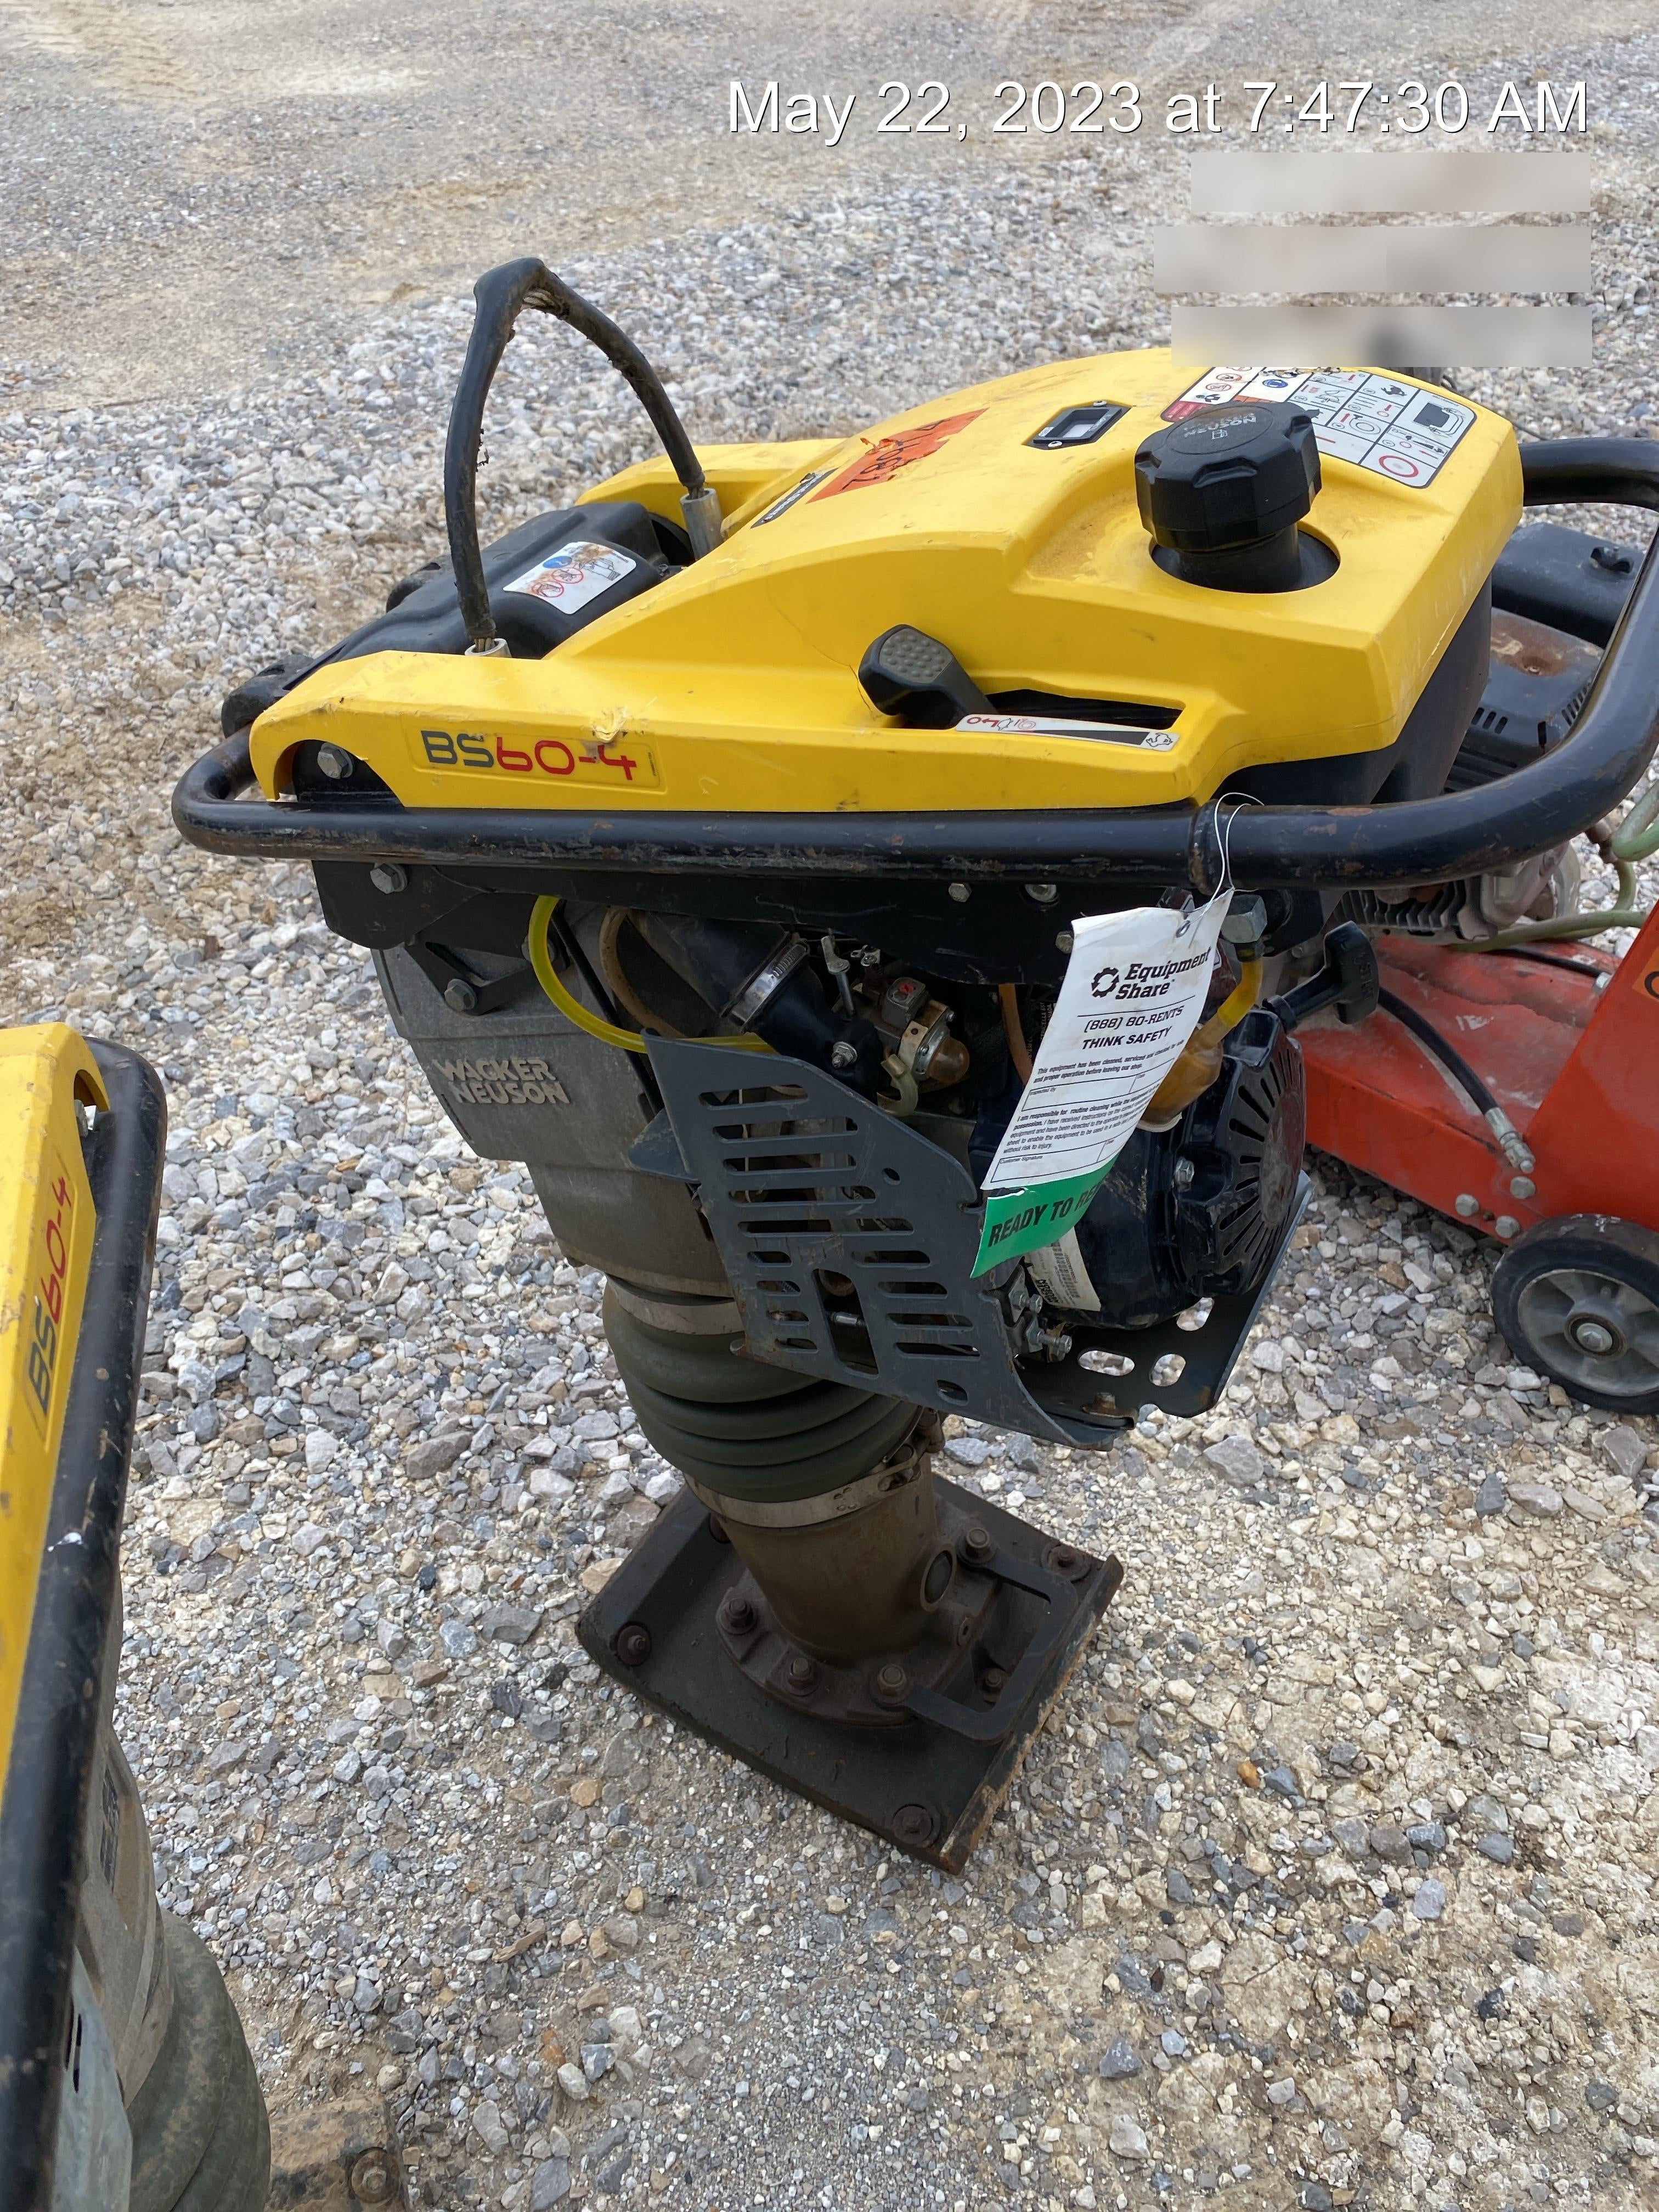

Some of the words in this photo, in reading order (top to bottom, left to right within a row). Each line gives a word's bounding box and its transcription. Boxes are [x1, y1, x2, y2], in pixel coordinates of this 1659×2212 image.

[420, 730, 637, 781] BS60-4
[1124, 946, 1211, 983] Equipment
[1115, 982, 1171, 1000] Share
[1084, 1016, 1124, 1033] (888)
[1126, 1005, 1185, 1027] 80-RENTS
[1081, 1035, 1125, 1050] THINK
[1125, 1026, 1172, 1045] SAFETY
[431, 1057, 556, 1081] WACKER
[1049, 1063, 1076, 1073] equipment
[449, 1081, 570, 1104] NEUSON
[988, 1204, 1049, 1248] READY
[1049, 1197, 1075, 1222] TO
[29, 1176, 72, 1417] BS60-4
